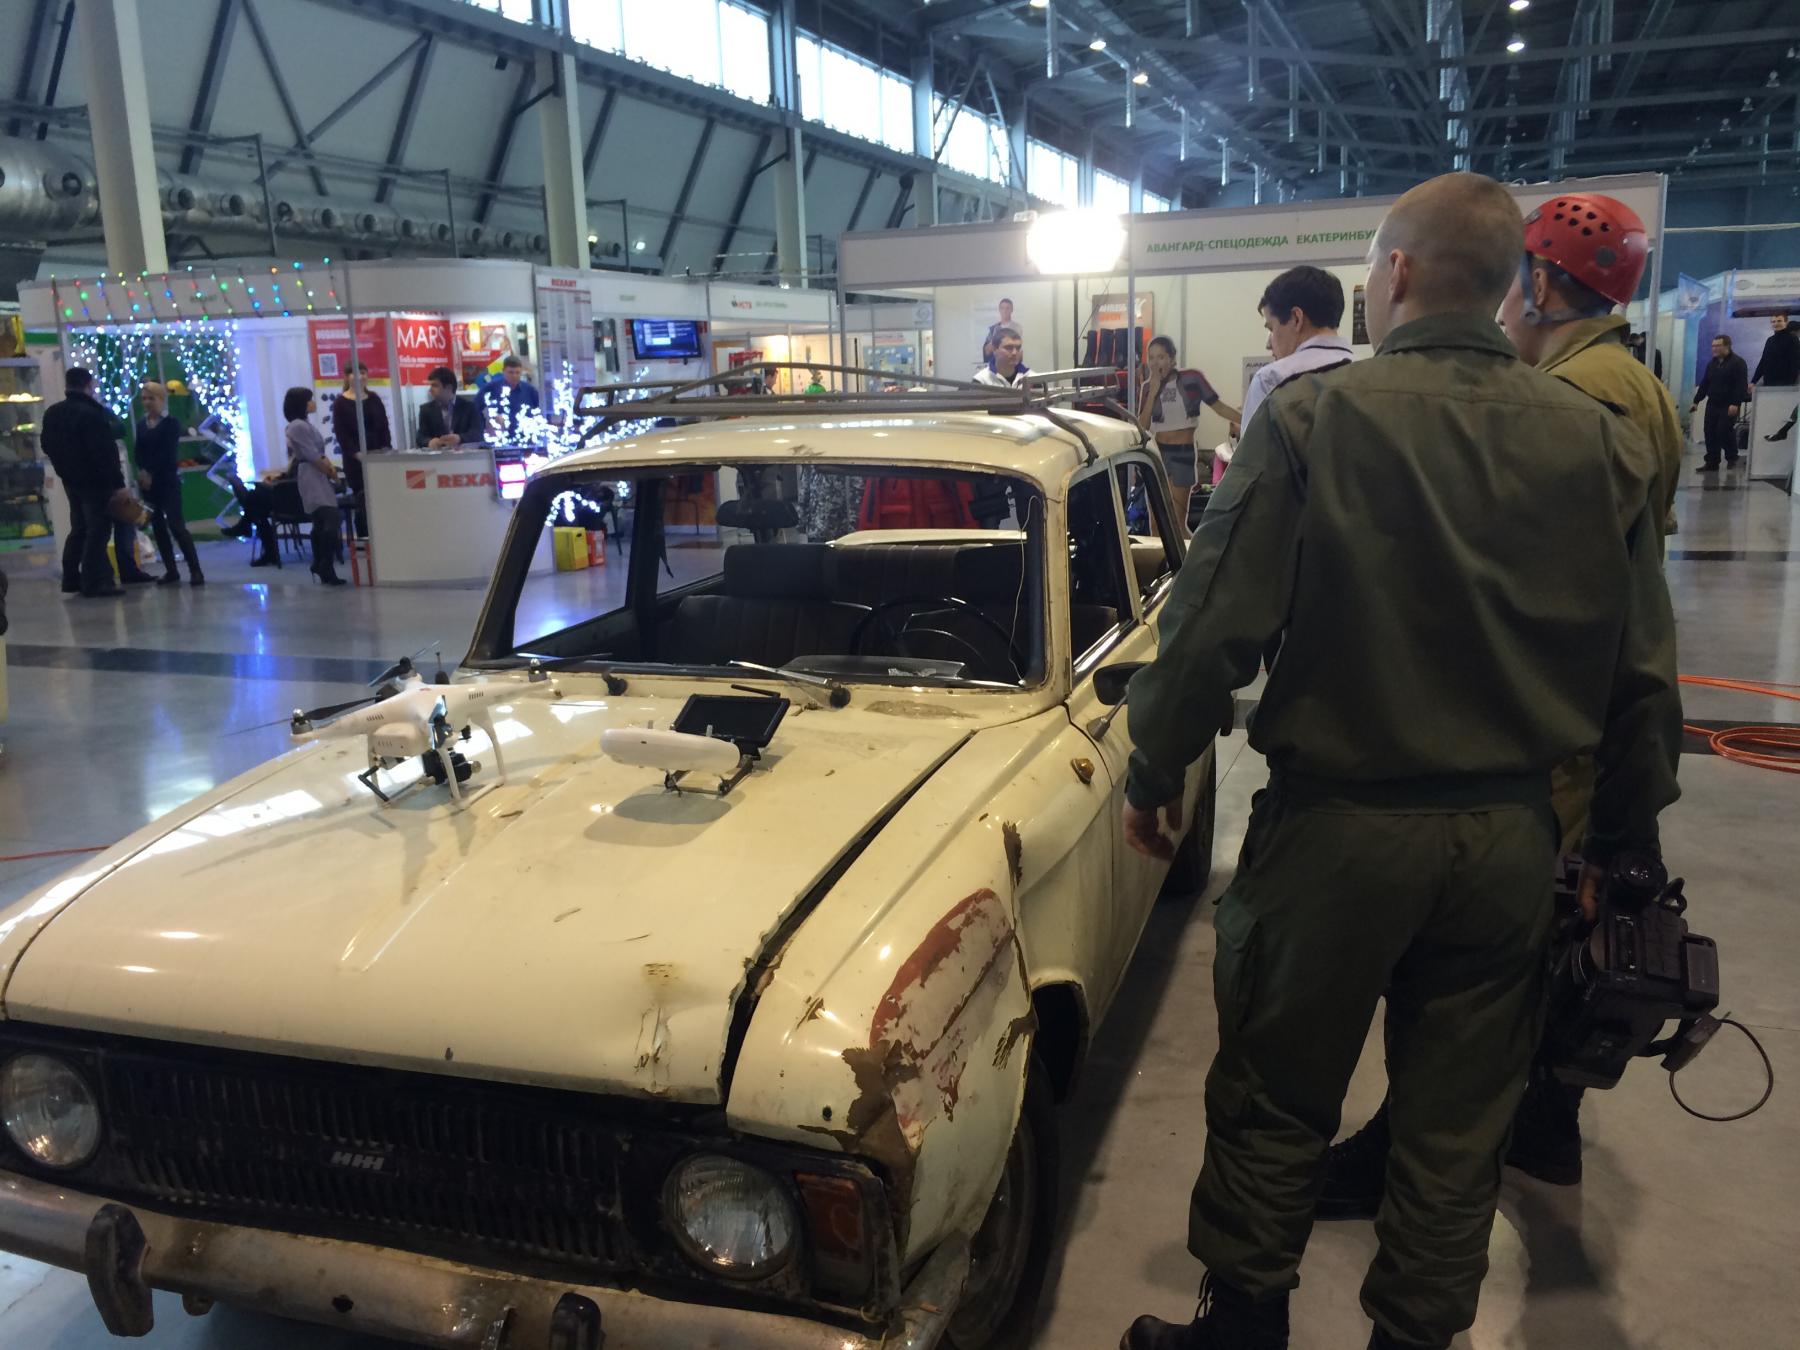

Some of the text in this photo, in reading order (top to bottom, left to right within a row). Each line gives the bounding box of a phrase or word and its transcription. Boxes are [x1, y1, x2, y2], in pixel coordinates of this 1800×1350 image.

[1147, 229, 1376, 253] АВАНГАРД-СПЕЦОДЕЖДА ЕКАТЕРИНБУ
[397, 325, 446, 349] MARS
[437, 473, 495, 489] REXA
